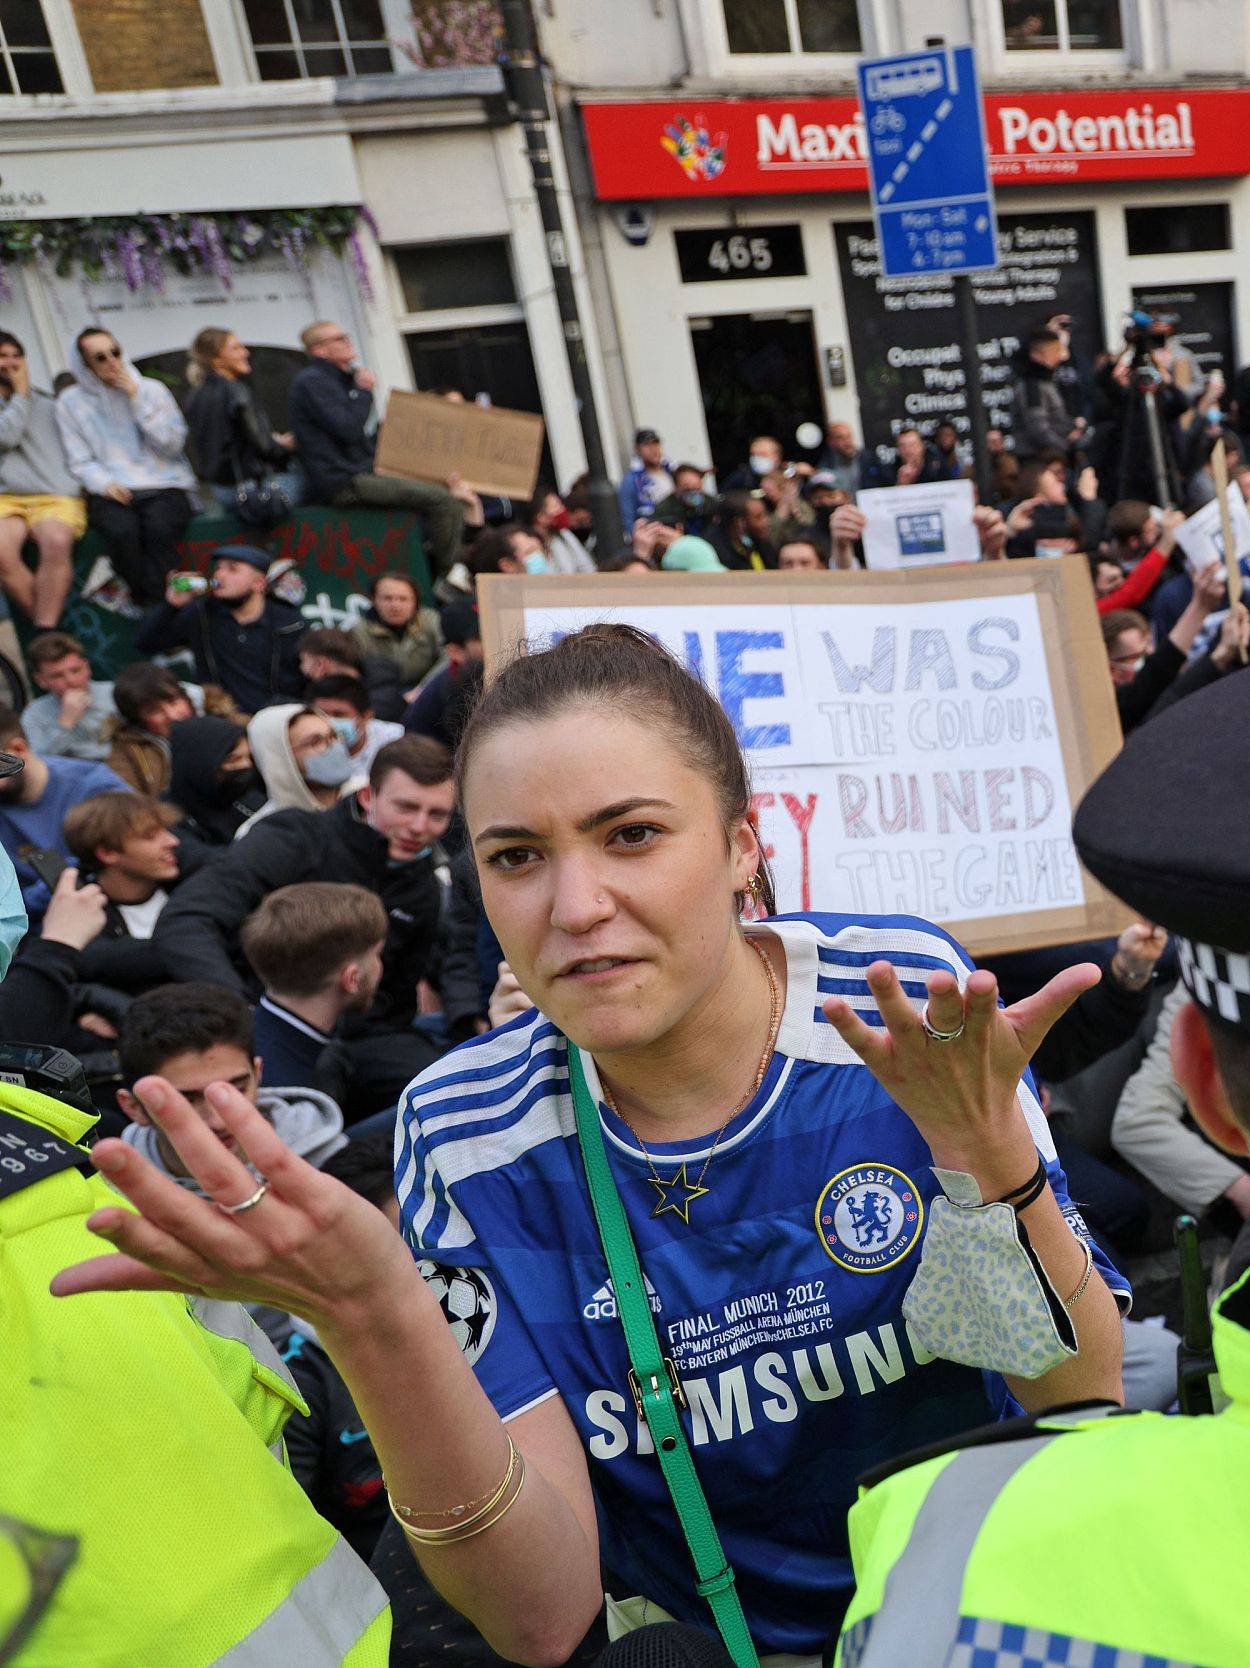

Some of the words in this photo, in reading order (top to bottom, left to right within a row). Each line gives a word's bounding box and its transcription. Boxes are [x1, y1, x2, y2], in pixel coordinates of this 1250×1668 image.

[757, 112, 868, 163] Maxi
[998, 102, 1195, 155] Potential
[708, 235, 773, 273] 465
[1014, 227, 1078, 248] Service
[885, 294, 905, 311] for
[906, 292, 955, 311] Childre
[974, 288, 1015, 307] Young
[1016, 285, 1057, 301] Adults
[819, 616, 1020, 693] WAS
[818, 702, 896, 756] THE
[907, 695, 1051, 751] COLOUR
[836, 765, 1055, 839] RUINED
[834, 848, 949, 914] THE
[953, 838, 1076, 908] GAME
[830, 1170, 894, 1201] CHELSEA
[843, 1253, 887, 1265] FOOTBALL
[889, 1235, 908, 1255] CLUB
[667, 1312, 721, 1344] FINAL
[723, 1293, 778, 1324] MUNICH
[786, 1280, 826, 1308] 2012
[671, 1340, 692, 1358] 19th
[692, 1336, 712, 1354] MAY
[713, 1322, 756, 1347] FUSSBALL
[757, 1313, 783, 1328] ARENA
[783, 1302, 830, 1325] MÜNCHEN
[675, 1359, 688, 1371] FC
[688, 1350, 728, 1370] BAYERN
[777, 1325, 819, 1341] CHELSEA
[819, 1317, 834, 1331] FC
[585, 1321, 938, 1460] SMSUN
